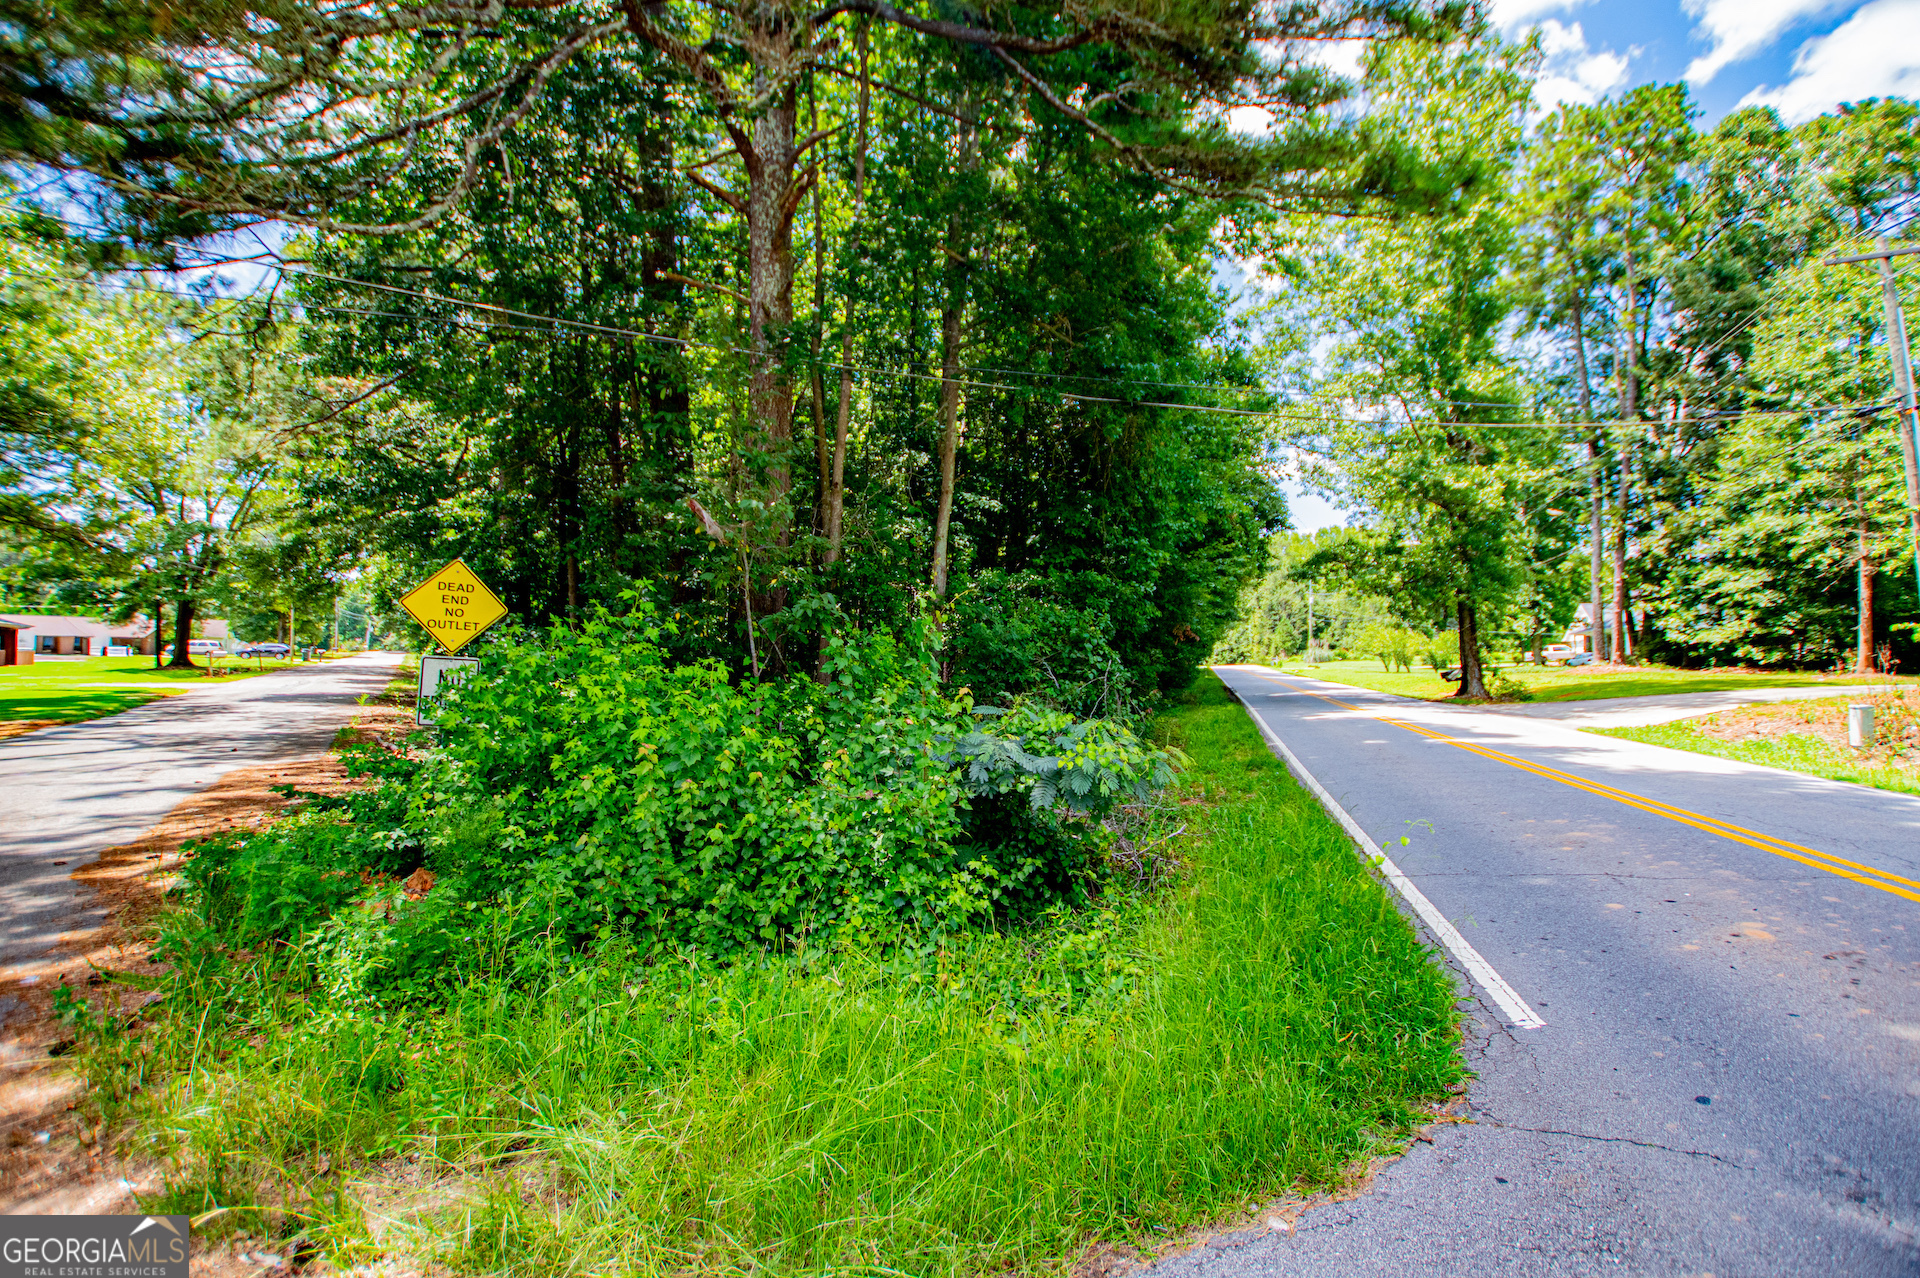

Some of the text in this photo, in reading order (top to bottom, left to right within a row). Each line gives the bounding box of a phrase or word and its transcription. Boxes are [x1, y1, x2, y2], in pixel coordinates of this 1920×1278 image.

[437, 581, 475, 593] DEAD
[441, 594, 469, 605] END
[444, 607, 465, 617] NO
[426, 619, 481, 632] OUTLET
